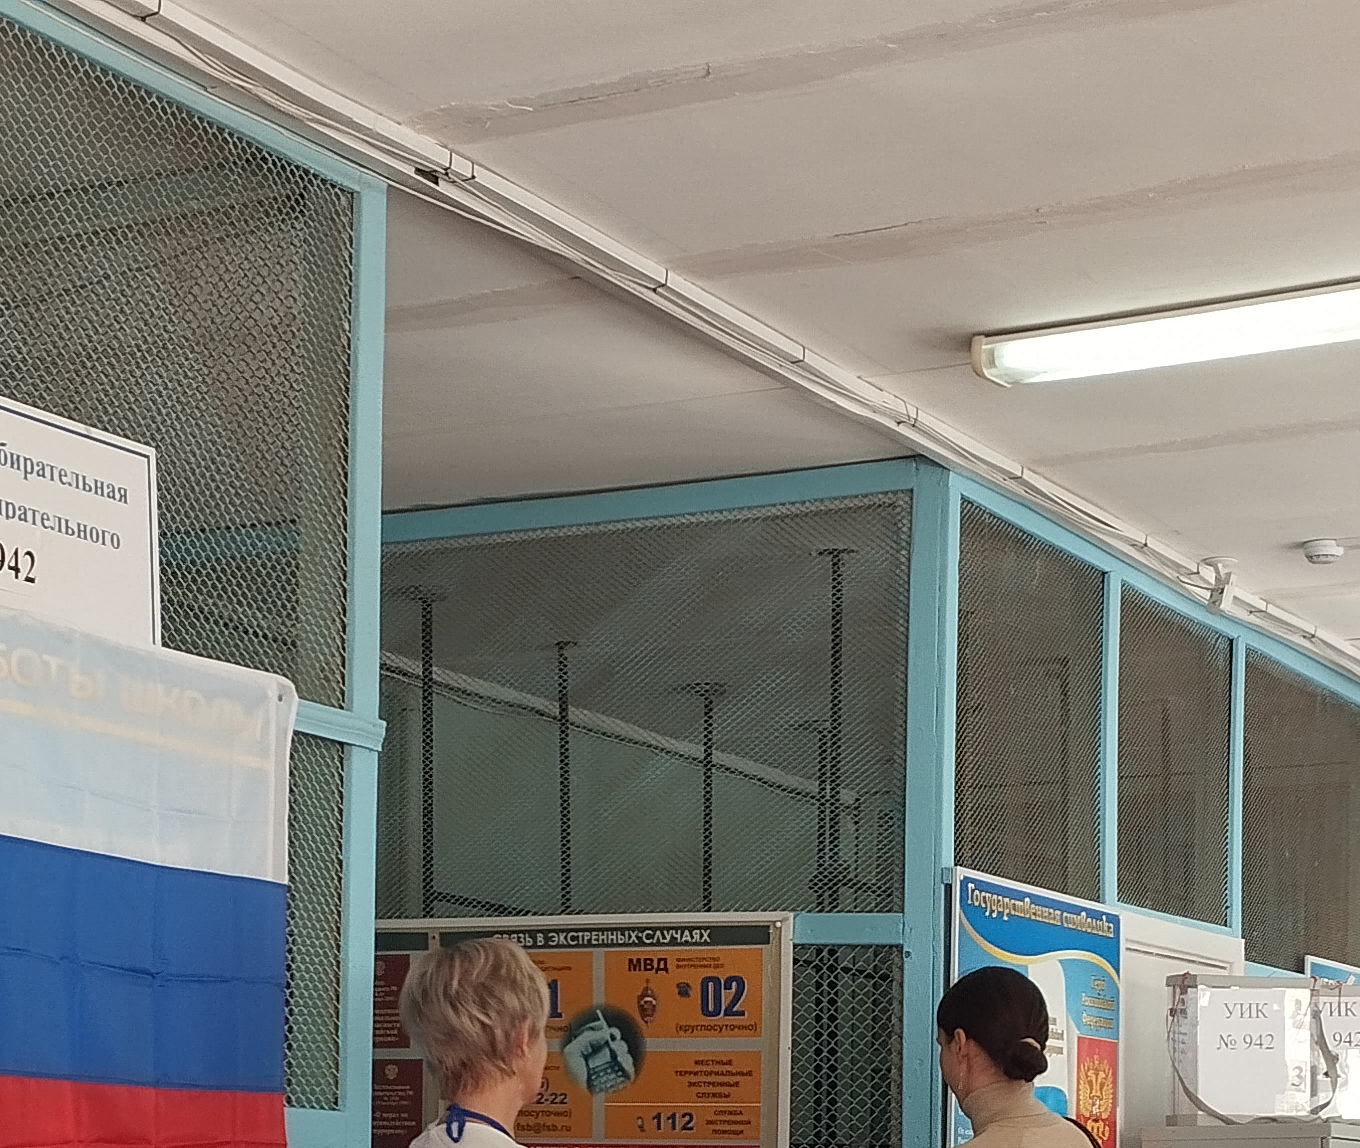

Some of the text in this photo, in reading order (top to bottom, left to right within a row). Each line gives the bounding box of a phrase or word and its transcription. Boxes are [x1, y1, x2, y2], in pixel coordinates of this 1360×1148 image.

[967, 882, 1061, 926] Государственная
[537, 933, 545, 946] В
[549, 929, 640, 946] ЭКСТРЕННЫХ
[642, 928, 711, 944] СЛУЧАЯХ
[627, 957, 669, 973] МВД
[548, 979, 563, 1019] 1
[700, 975, 747, 1019] 02
[1223, 1002, 1269, 1019] УИК
[675, 1022, 758, 1033] (круглосуточно)
[1216, 1033, 1275, 1051] № 942
[652, 1111, 695, 1131] 112
